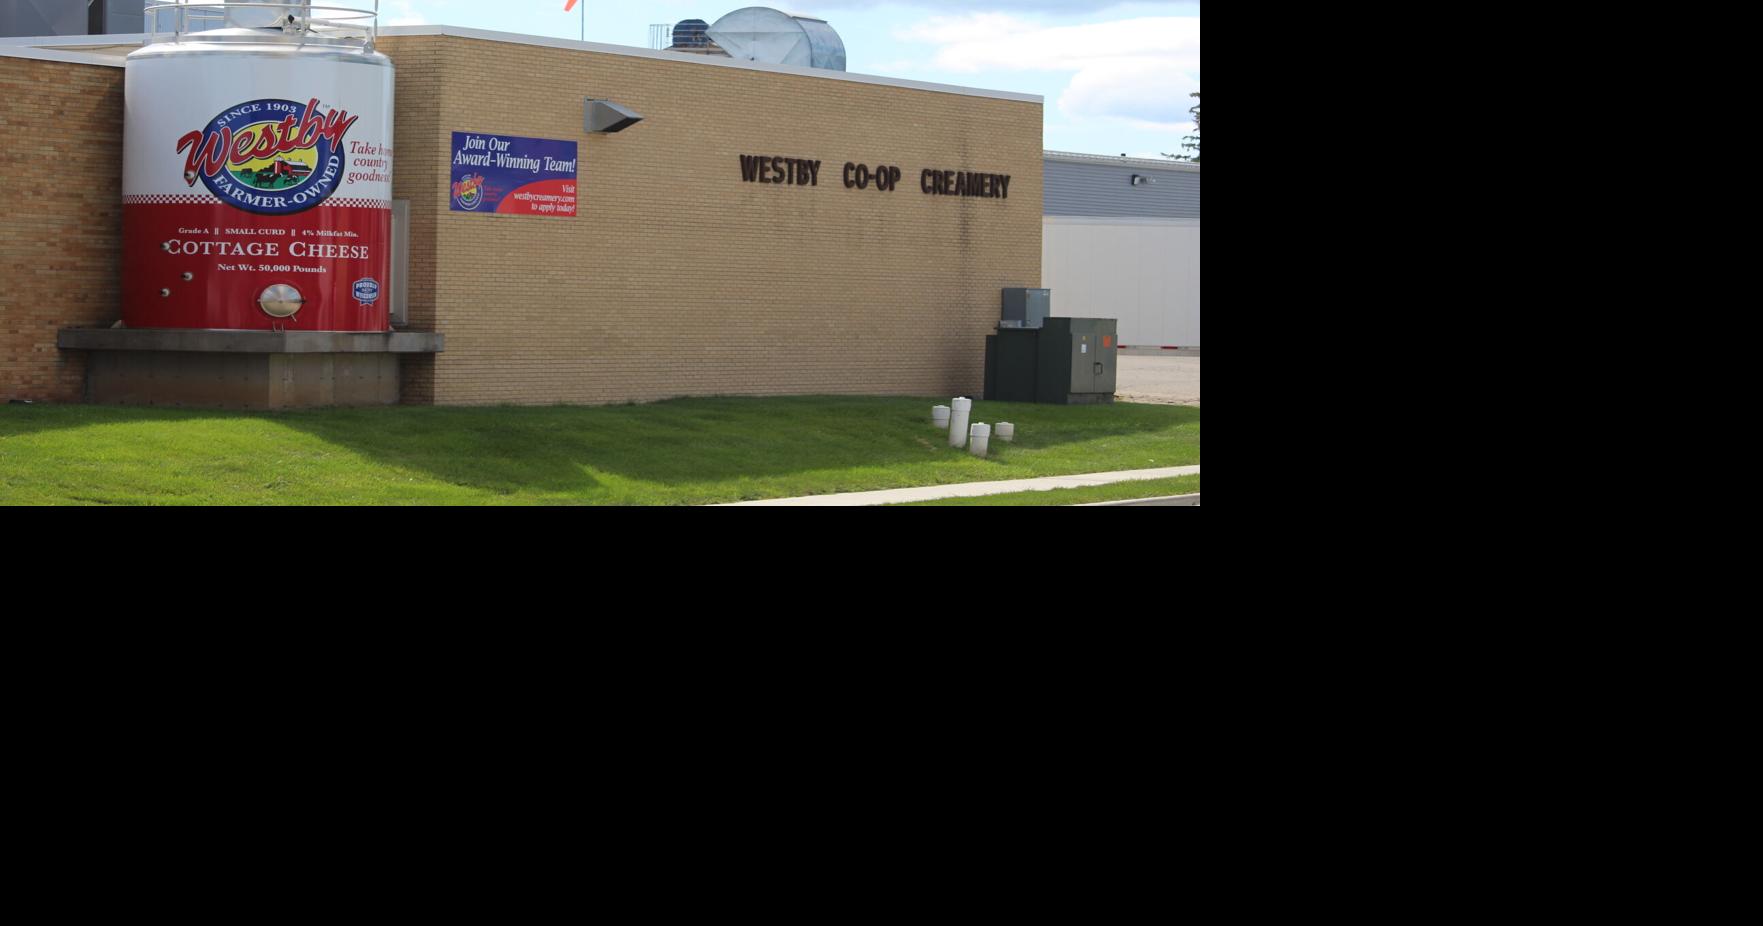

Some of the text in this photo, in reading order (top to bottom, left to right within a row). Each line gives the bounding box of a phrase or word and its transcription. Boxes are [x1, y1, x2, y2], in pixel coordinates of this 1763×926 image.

[216, 102, 297, 127] SINCE 1903
[176, 98, 359, 188] Westby
[350, 141, 377, 155] Take
[463, 135, 511, 152] Join Our
[452, 150, 576, 174] Award-Winning Team!
[213, 155, 340, 208] FARMER-OWNED
[739, 154, 1012, 200] WESTBY CO-OP CREAMERY
[178, 227, 202, 235] Grade
[258, 228, 286, 236] CURD
[302, 229, 314, 237] 4%
[316, 229, 343, 238] Milkfat
[168, 238, 369, 260] COTTAGE CHEESE
[217, 263, 327, 273] Net Wt. 50,000 Pounds
